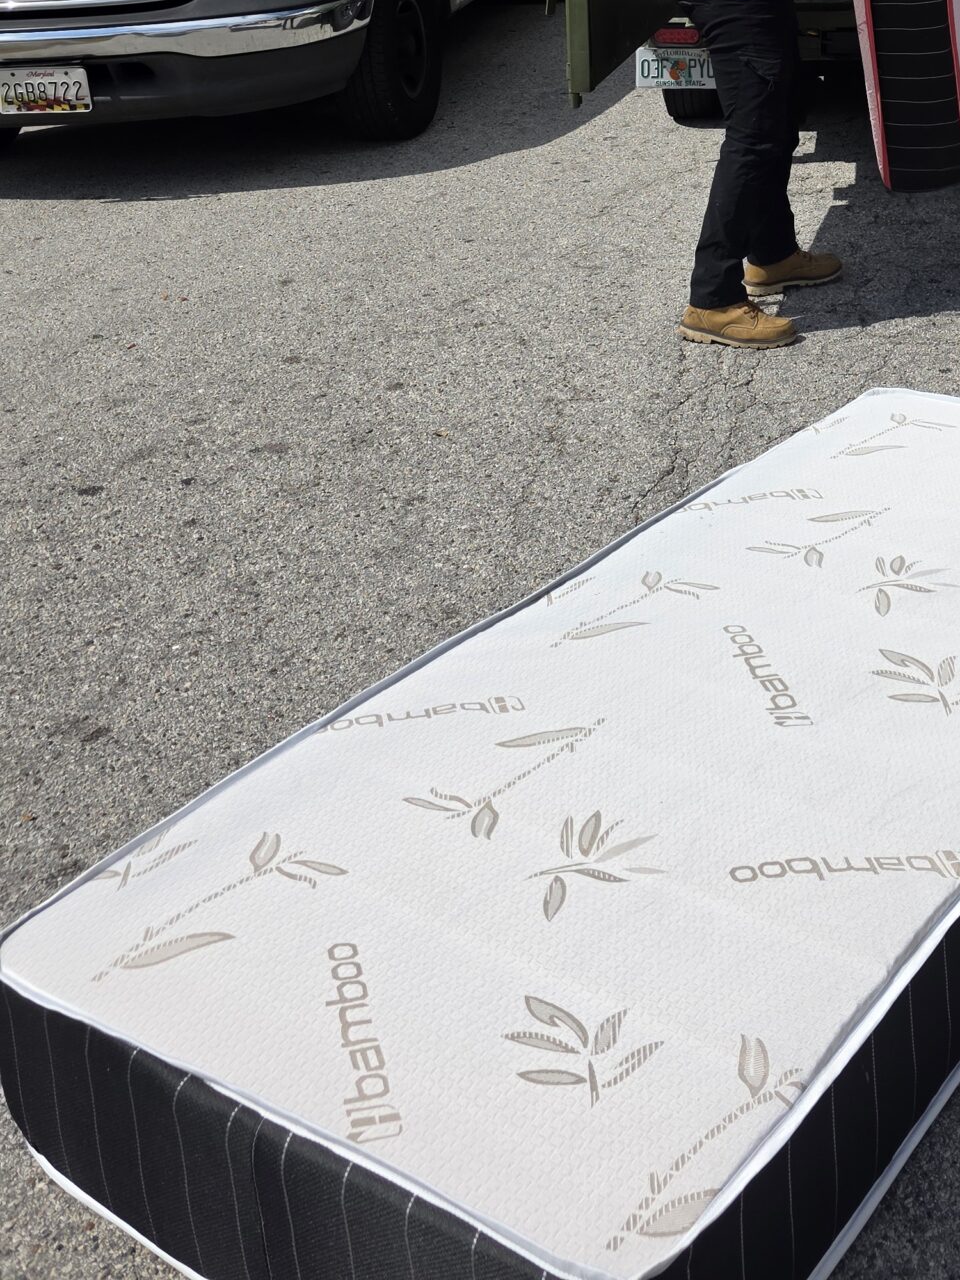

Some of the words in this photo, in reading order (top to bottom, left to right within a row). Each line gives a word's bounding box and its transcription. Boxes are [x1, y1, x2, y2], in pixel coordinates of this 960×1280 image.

[1, 80, 85, 105] 2GB8722
[722, 624, 798, 711] bamboo
[728, 855, 948, 884] bamboo
[324, 942, 391, 1106] bamboo
